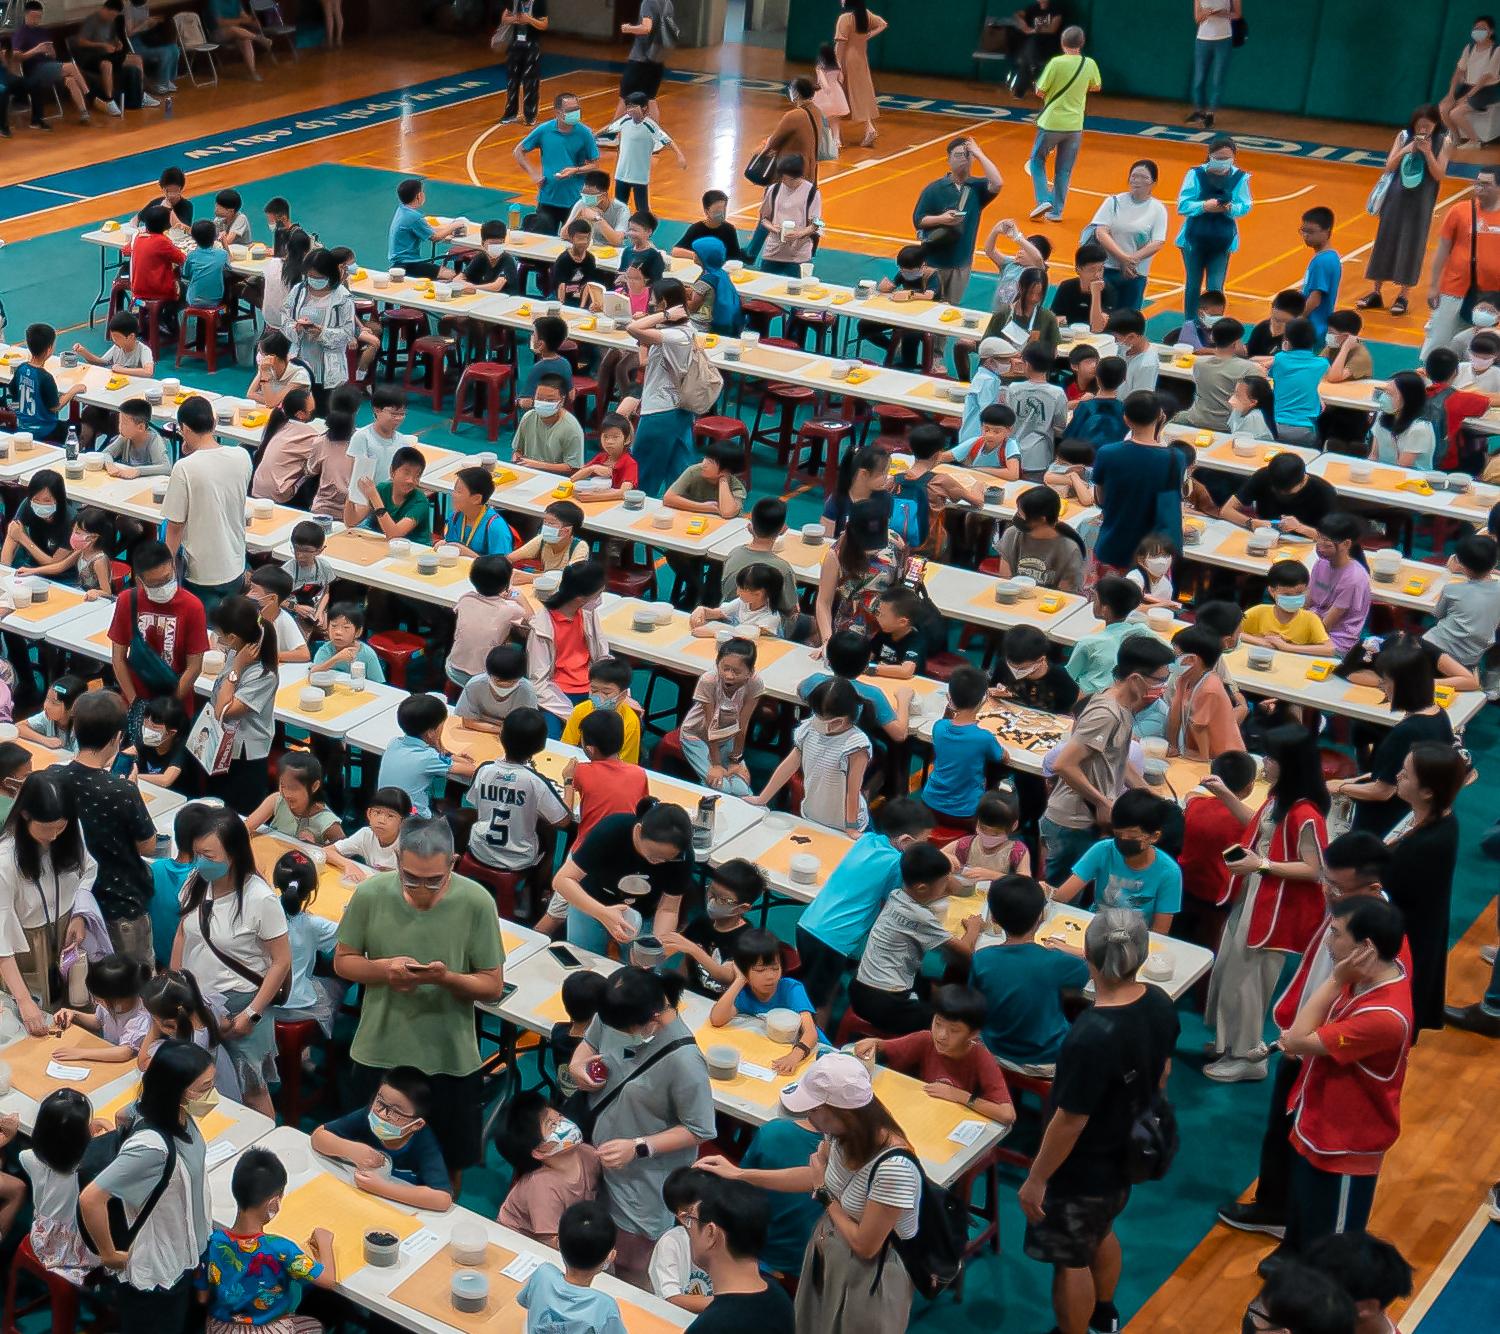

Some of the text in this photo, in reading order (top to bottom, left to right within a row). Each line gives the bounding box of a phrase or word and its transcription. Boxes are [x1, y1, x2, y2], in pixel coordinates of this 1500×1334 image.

[19, 384, 36, 417] 15
[481, 783, 526, 807] LUCAS
[486, 808, 511, 847] 5
